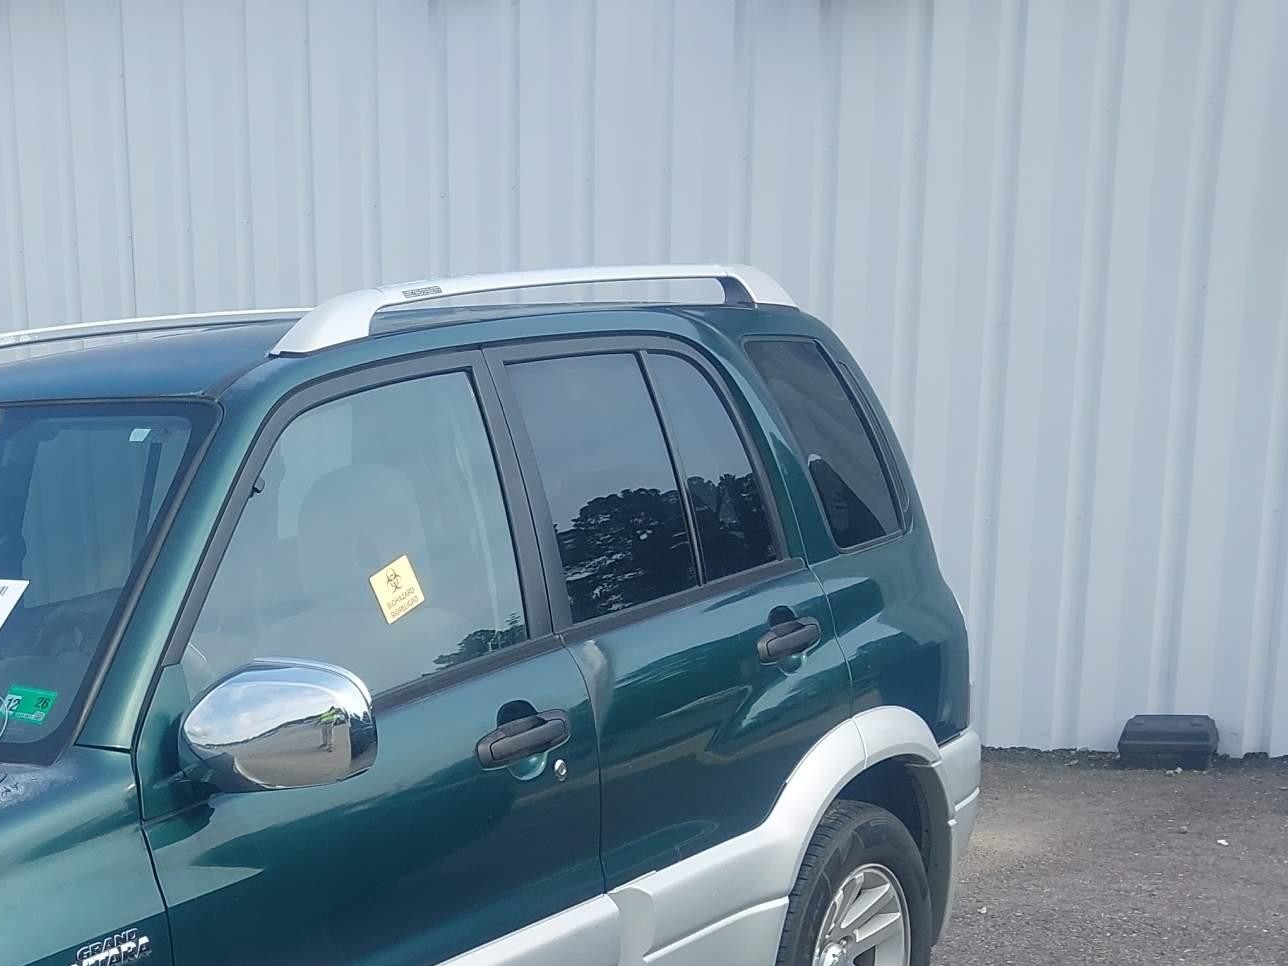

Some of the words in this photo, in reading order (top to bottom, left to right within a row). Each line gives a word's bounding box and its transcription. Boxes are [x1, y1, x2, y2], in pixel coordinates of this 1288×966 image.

[7, 698, 22, 712] 12
[34, 696, 51, 710] 26
[76, 927, 138, 960] GRAND
